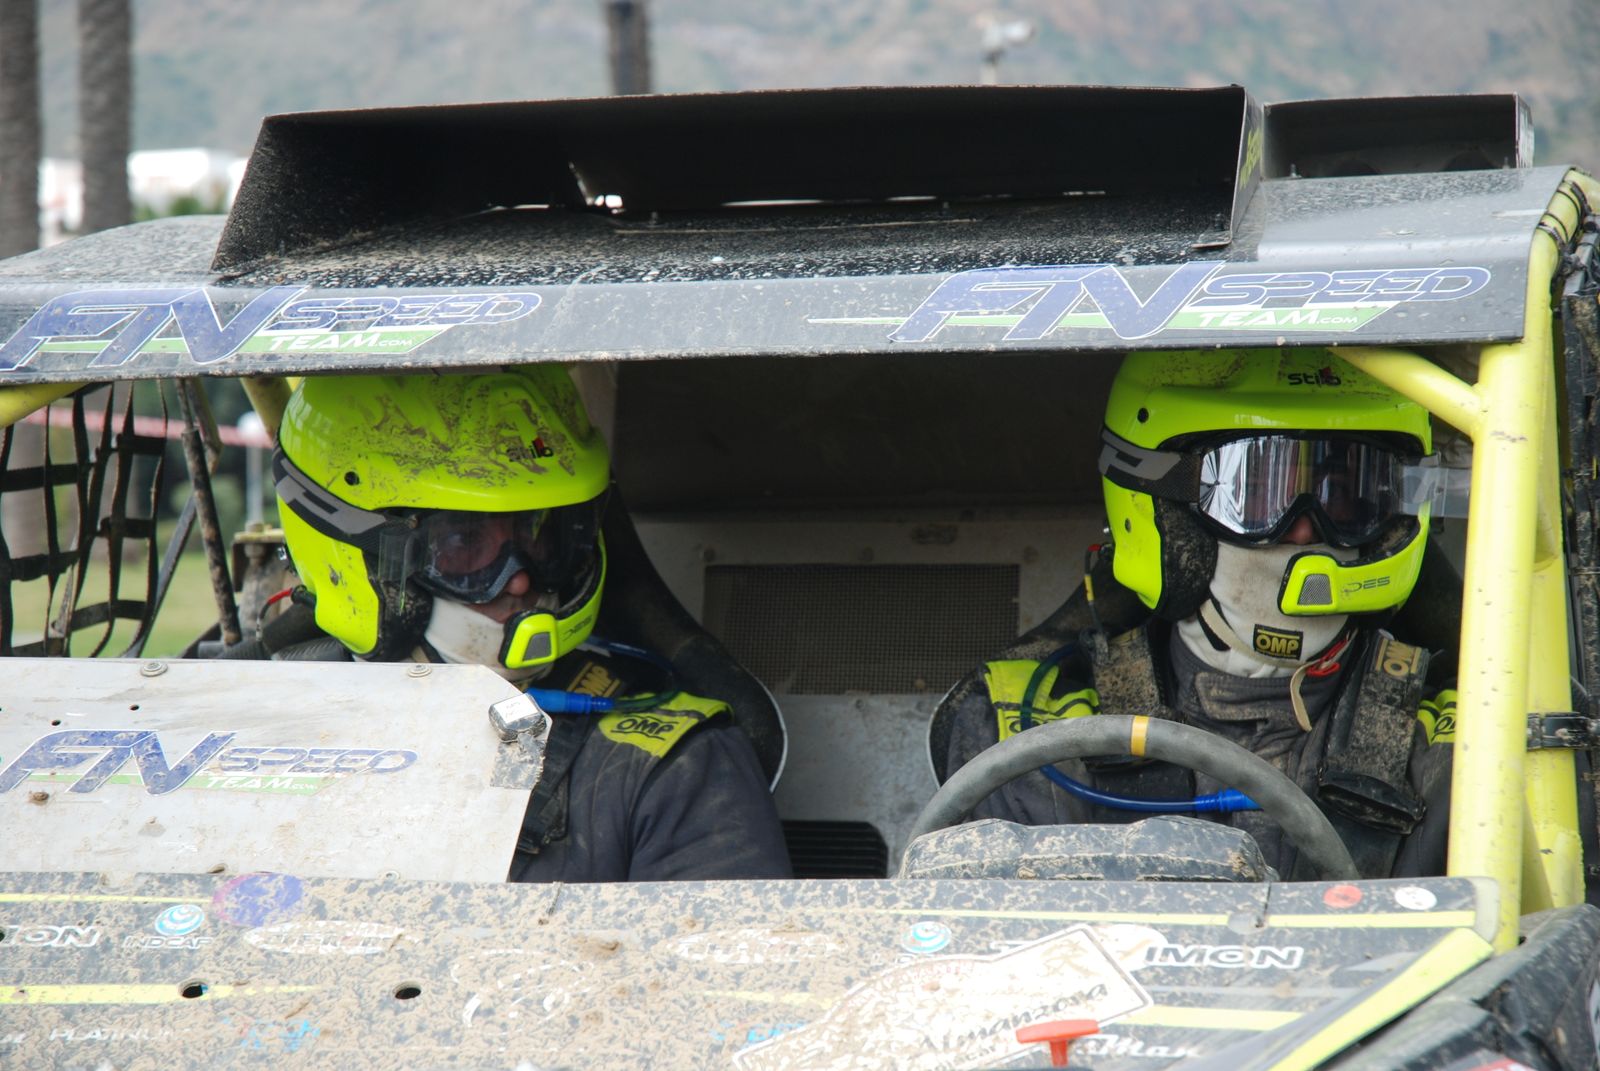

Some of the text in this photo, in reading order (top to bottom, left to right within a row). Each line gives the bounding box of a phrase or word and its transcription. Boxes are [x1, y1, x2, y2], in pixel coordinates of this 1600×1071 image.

[1186, 266, 1491, 308] SPEED
[264, 292, 542, 332] SPEED
[1256, 634, 1299, 655] OMP
[616, 718, 674, 734] OMP
[211, 747, 419, 774] SPEED
